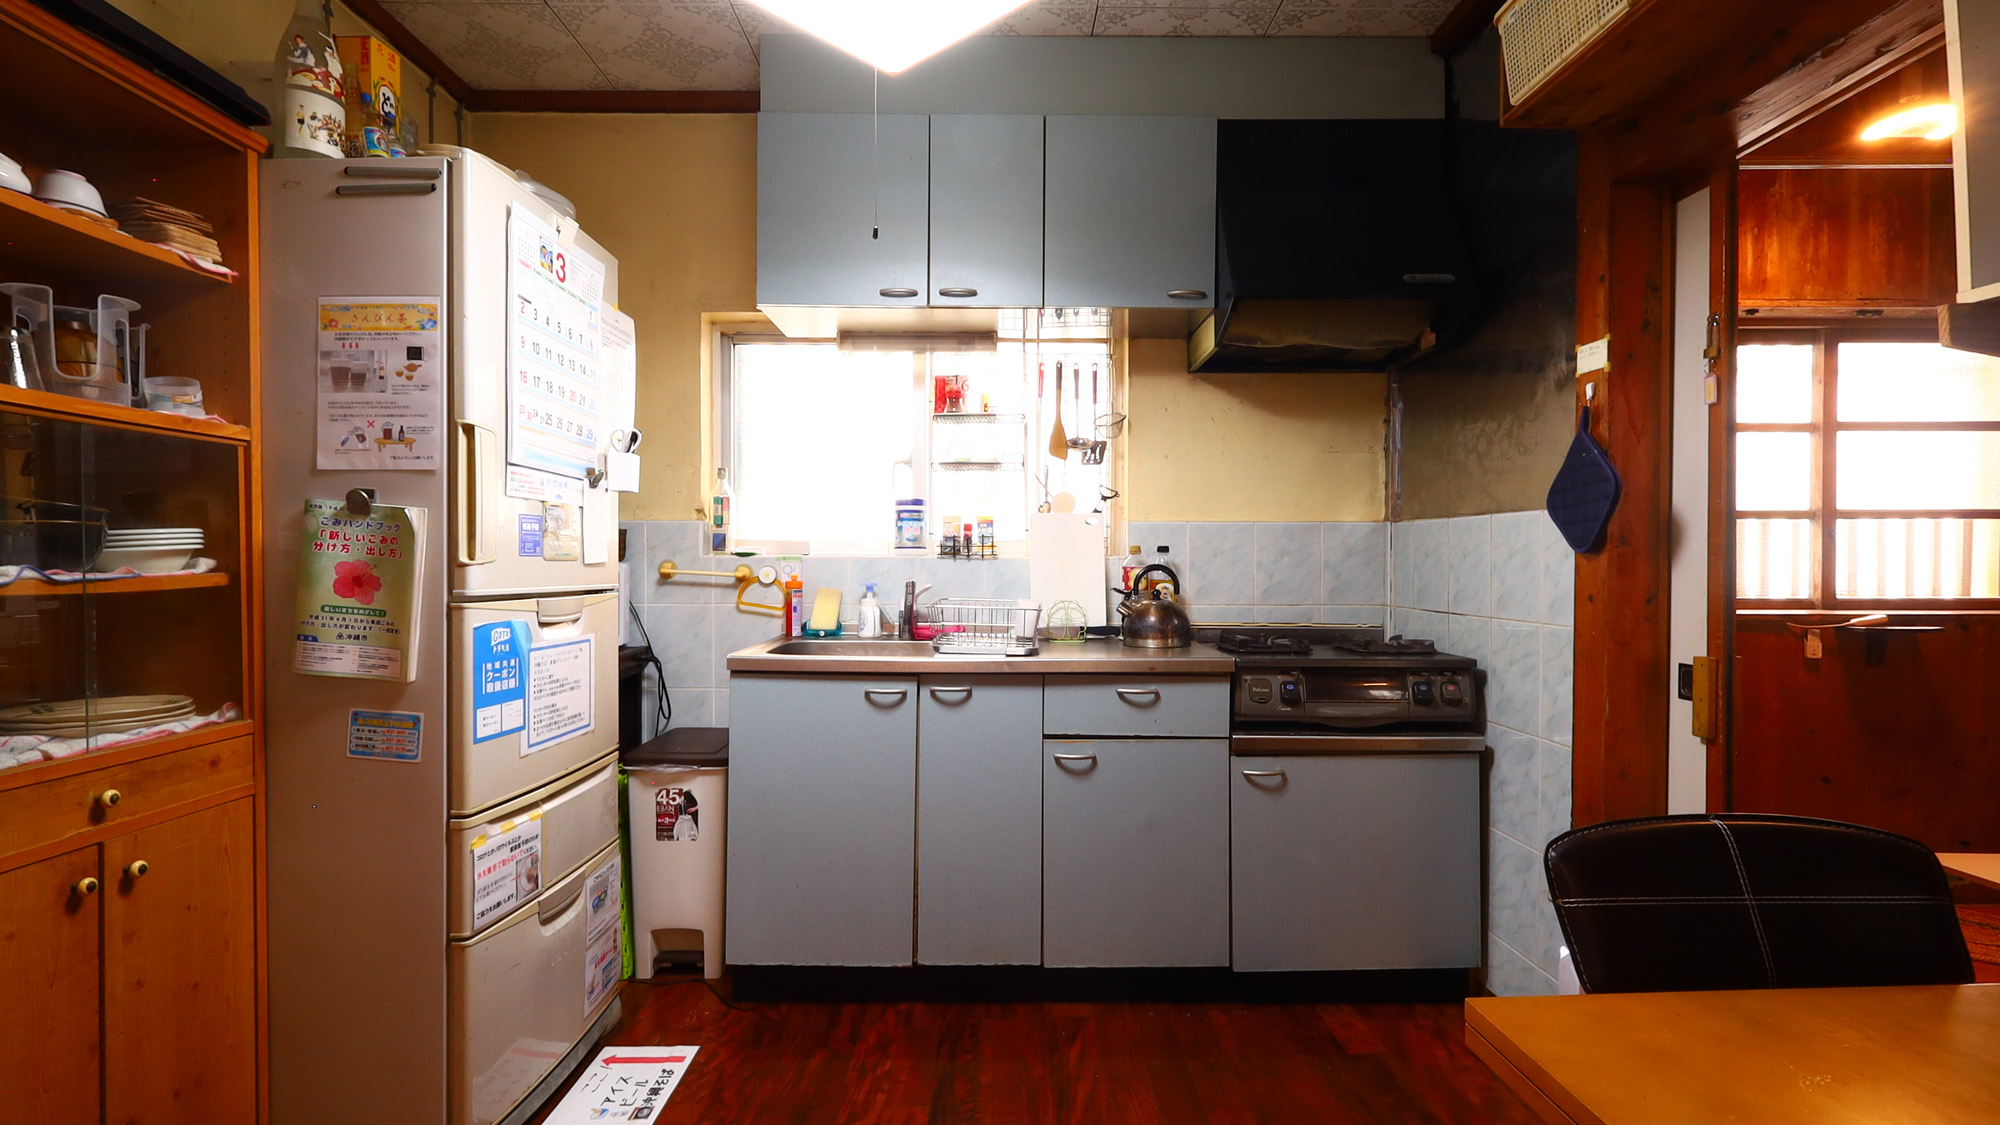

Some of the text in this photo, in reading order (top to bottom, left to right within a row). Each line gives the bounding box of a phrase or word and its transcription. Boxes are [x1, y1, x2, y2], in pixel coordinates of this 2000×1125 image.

[556, 252, 566, 283] 3
[351, 312, 407, 324] さんぴん茶
[520, 301, 525, 314] 2
[533, 308, 538, 320] 3
[545, 316, 550, 327] 4
[557, 321, 562, 334] 5
[568, 328, 573, 340] 6
[579, 333, 584, 345] 7
[520, 336, 525, 348] 9
[532, 342, 540, 355] 10
[545, 348, 552, 360] 11
[557, 353, 564, 366] 12
[568, 359, 575, 371] 13
[579, 364, 586, 375] 14
[519, 370, 528, 384] 16
[533, 375, 541, 388] 17
[546, 380, 554, 393] 18
[558, 385, 565, 398] 19
[569, 389, 577, 402] 20
[579, 394, 586, 406] 21
[545, 413, 553, 426] 25
[556, 417, 563, 430] 26
[567, 420, 573, 432] 27
[576, 424, 583, 437] 28
[586, 428, 594, 440] 29
[320, 516, 401, 532] ごみハンドブック
[319, 529, 399, 546] 「新しいごみの
[313, 541, 402, 559] 分け方・出し方」
[345, 633, 368, 641] 沖縄市
[492, 643, 509, 653] トラベル
[486, 658, 516, 670] 地域共通
[486, 668, 516, 682] クーポン
[486, 678, 516, 693] 取扱店舗
[657, 789, 680, 805] 45
[600, 1076, 633, 1106] アイス
[619, 1079, 648, 1106] ビール
[641, 1068, 674, 1107] 沖縄そば
